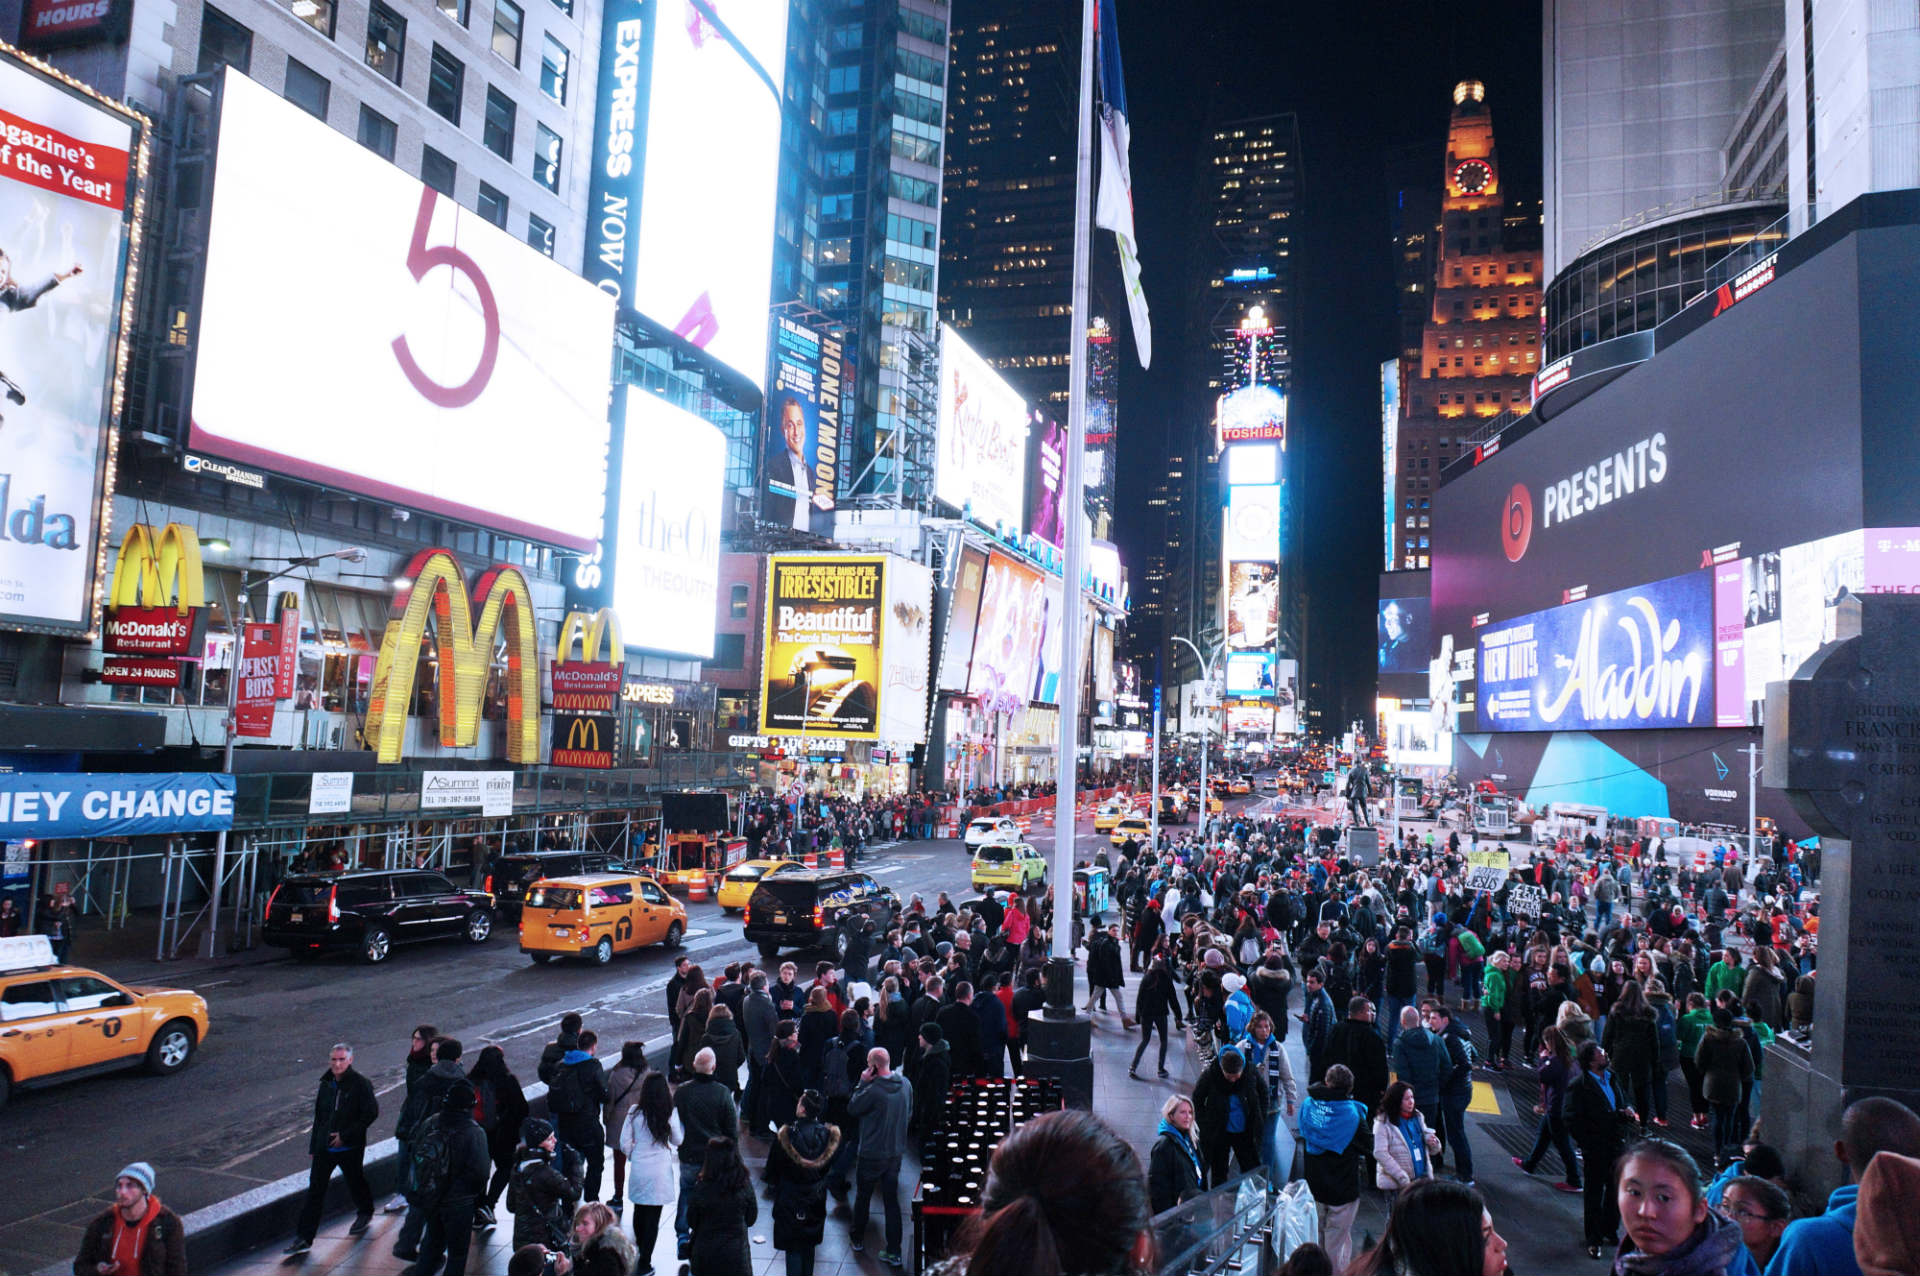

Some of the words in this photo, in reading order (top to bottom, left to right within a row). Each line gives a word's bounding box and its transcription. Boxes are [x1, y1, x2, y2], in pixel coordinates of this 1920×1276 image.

[36, 1, 110, 28] HOURS
[606, 18, 642, 179] EXPRESS
[15, 152, 53, 180] the
[57, 164, 112, 202] Year!
[600, 191, 629, 275] NOW
[1734, 253, 1779, 288] MARRIOTT
[1734, 269, 1774, 301] MARQUIS
[815, 337, 842, 500] HONEYMOON
[1223, 427, 1283, 440] TOSHIBA
[1543, 432, 1668, 529] PRESENTS
[105, 620, 187, 637] McDonald's
[778, 605, 874, 632] Beautiful
[116, 638, 171, 649] Restaurant
[103, 666, 129, 676] OPEN
[130, 667, 143, 677] 24
[143, 667, 177, 679] HOURS
[240, 655, 280, 679] JERSEY
[1484, 647, 1508, 683] NEW
[1537, 596, 1703, 724] Aladdin
[245, 677, 275, 699] BOYS
[281, 655, 291, 695] HOURS
[553, 671, 619, 682] McDonald's
[563, 681, 607, 690] Restaurant
[728, 734, 769, 748] GIFTS
[438, 776, 480, 788] Summit
[1704, 788, 1738, 799] VORNADO
[82, 788, 234, 821] CHANGE
